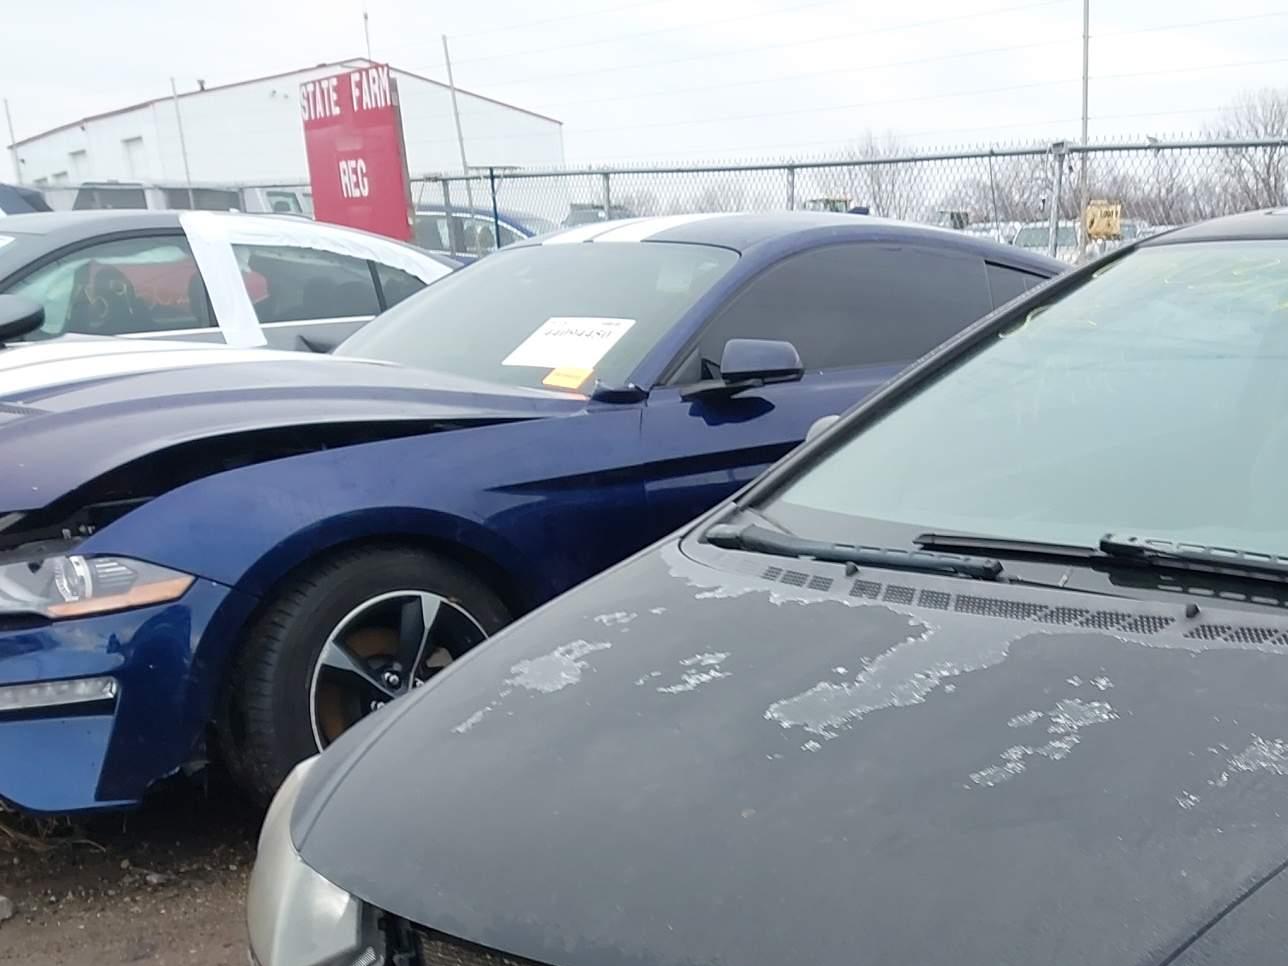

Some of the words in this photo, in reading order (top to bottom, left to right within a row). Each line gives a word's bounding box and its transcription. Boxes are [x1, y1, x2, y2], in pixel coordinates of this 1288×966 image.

[300, 76, 341, 121] STATE
[350, 65, 392, 112] FARM
[339, 158, 369, 198] REC
